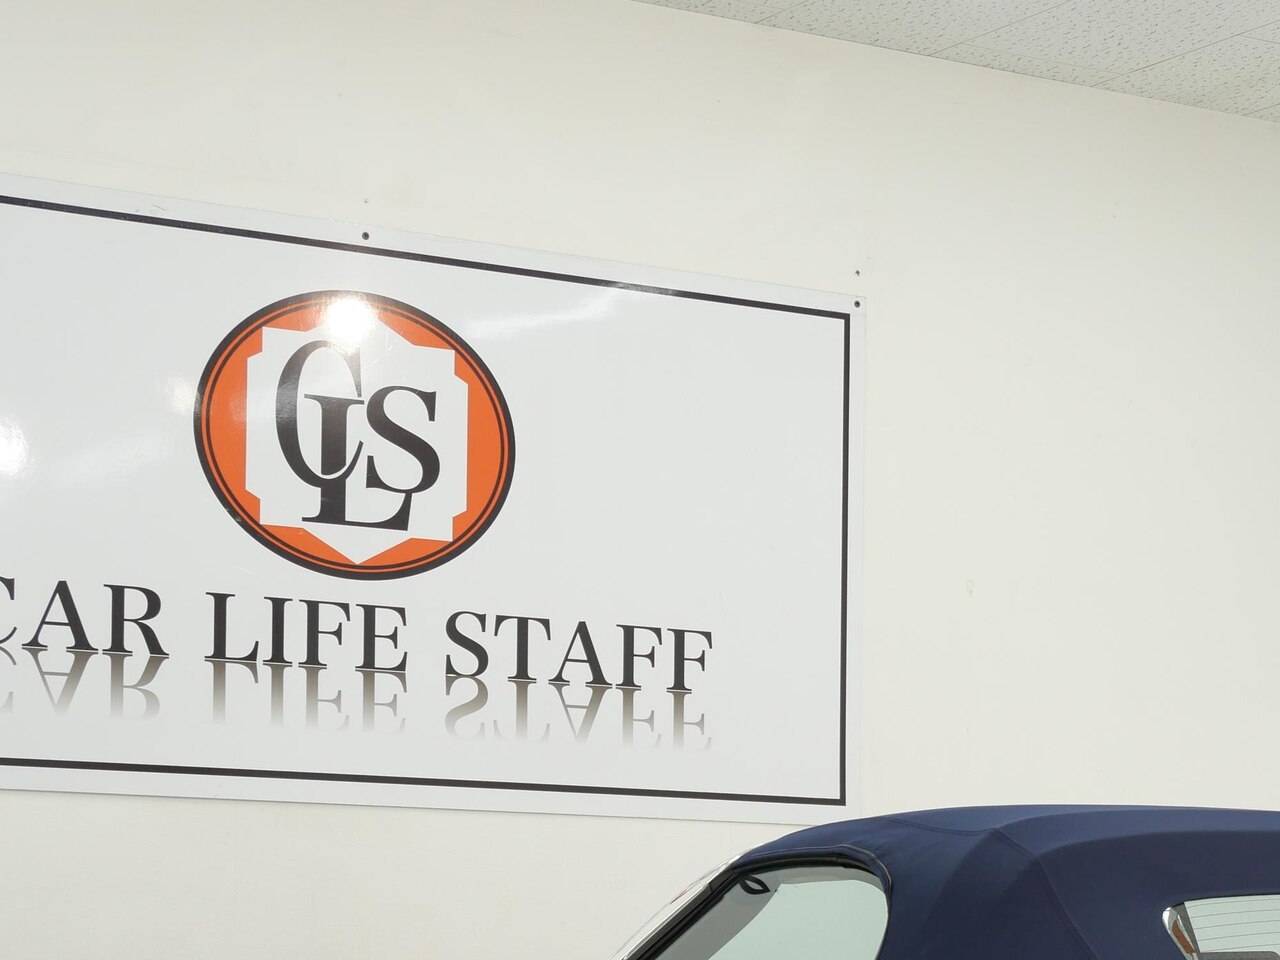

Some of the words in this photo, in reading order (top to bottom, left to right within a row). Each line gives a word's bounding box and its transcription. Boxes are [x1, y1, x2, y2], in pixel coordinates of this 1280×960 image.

[274, 339, 441, 532] CLS
[0, 576, 170, 656] AR
[204, 591, 408, 673] LIFE
[444, 610, 713, 693] STAFF
